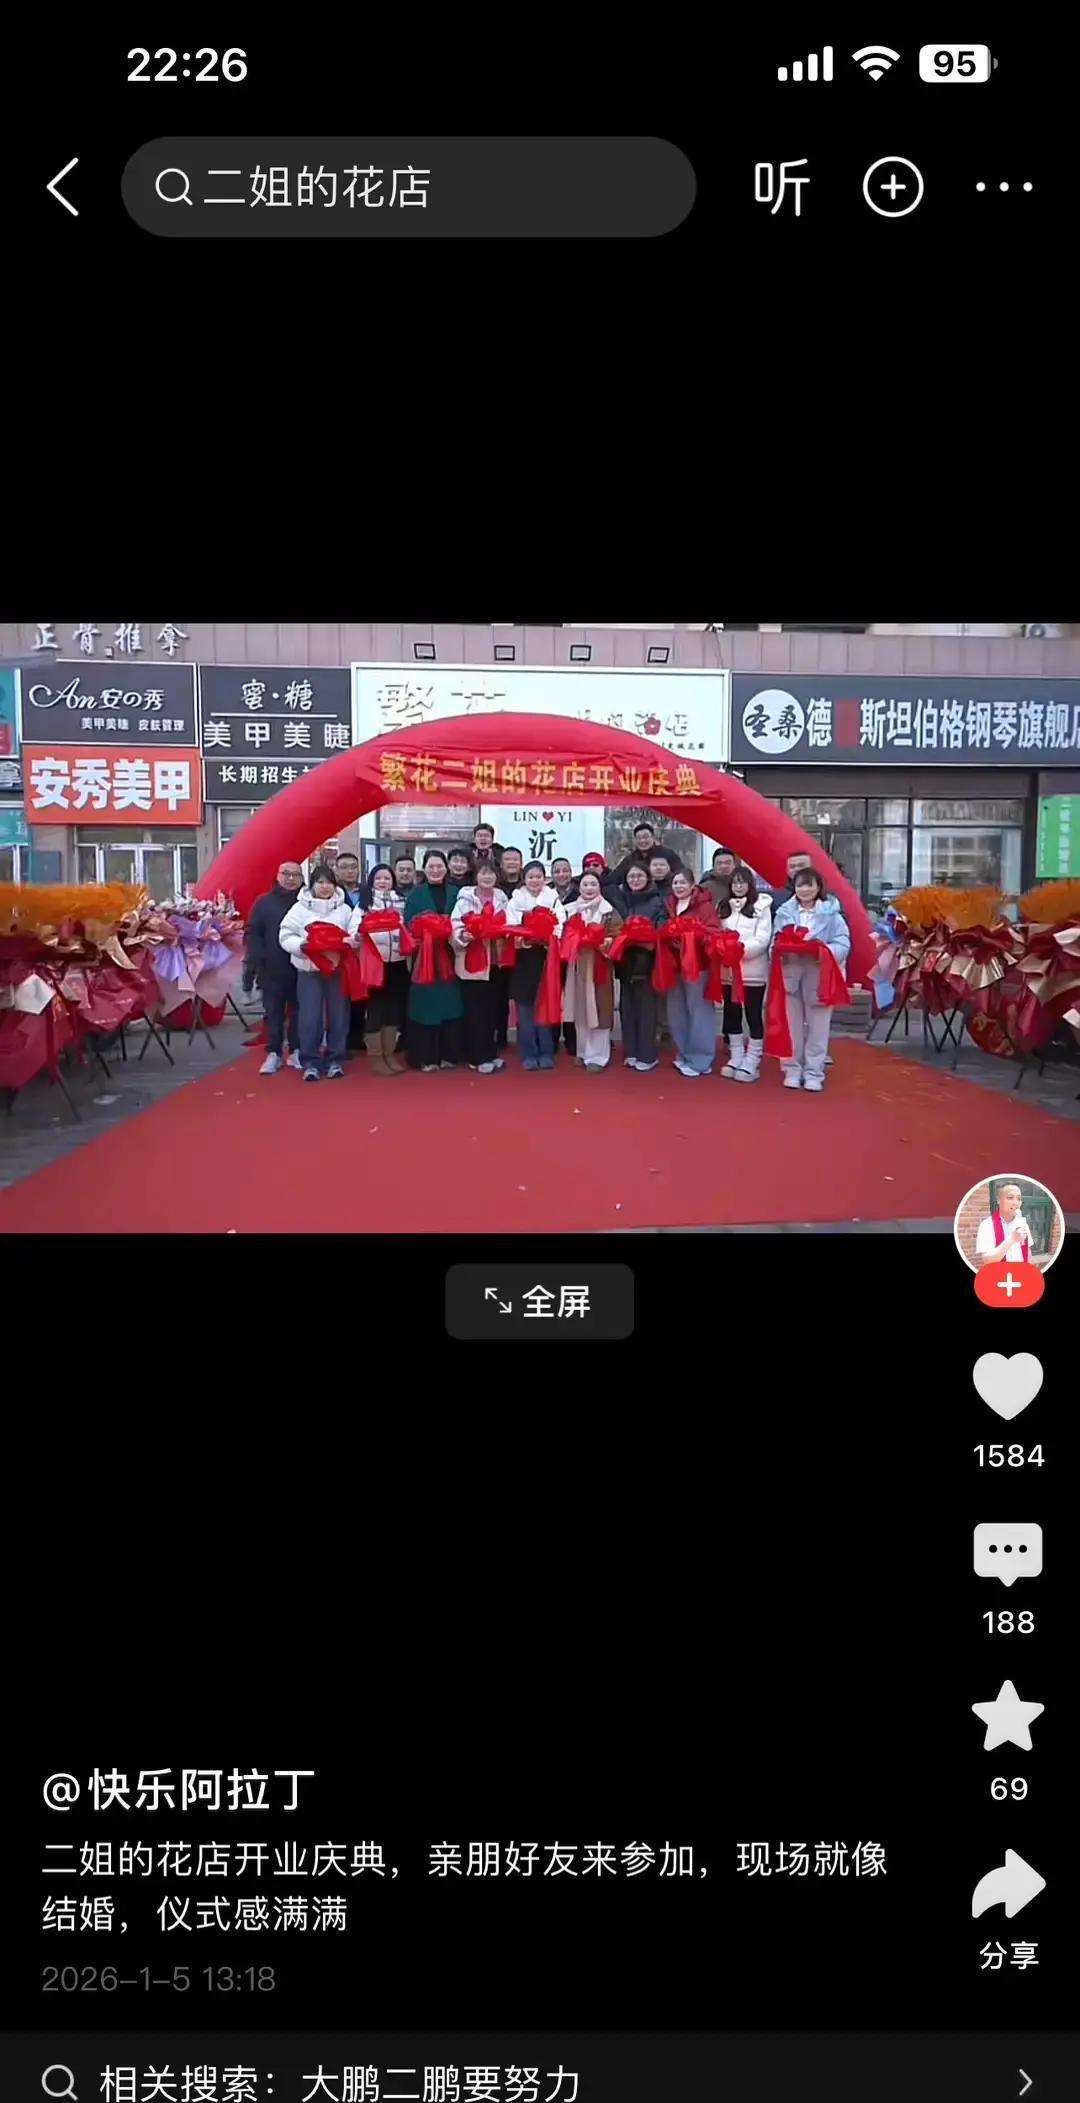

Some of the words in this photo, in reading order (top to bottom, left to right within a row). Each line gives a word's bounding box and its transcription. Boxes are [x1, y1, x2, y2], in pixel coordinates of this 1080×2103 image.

[203, 720, 350, 748] 美甲美睫
[30, 757, 191, 811] 安秀美甲
[218, 765, 312, 783] 长期招生
[379, 751, 703, 797] 繁花二姐的花店开业庆典
